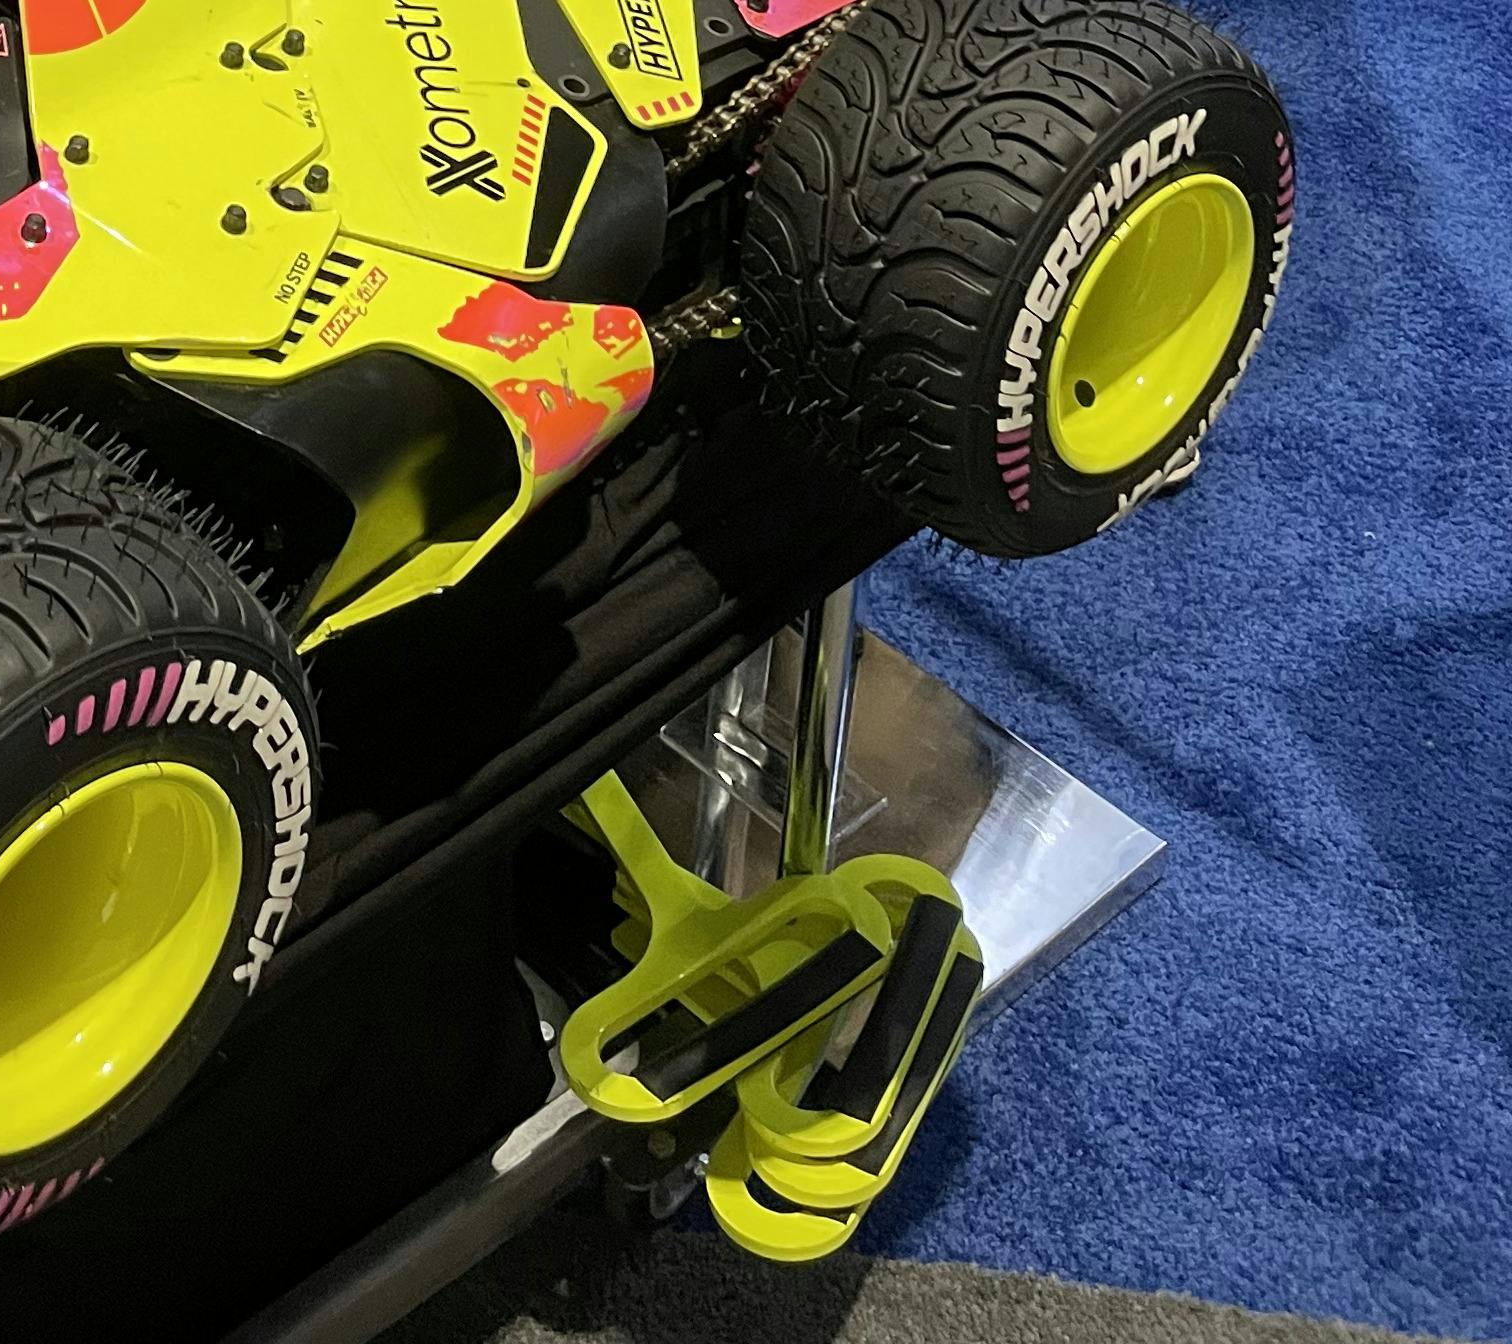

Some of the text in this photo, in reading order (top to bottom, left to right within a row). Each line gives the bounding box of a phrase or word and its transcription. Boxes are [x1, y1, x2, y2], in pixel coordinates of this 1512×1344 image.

[274, 252, 311, 305] NO STEP
[996, 108, 1207, 432] HYPERSHOCK
[167, 660, 313, 997] HYPERSHOCK
